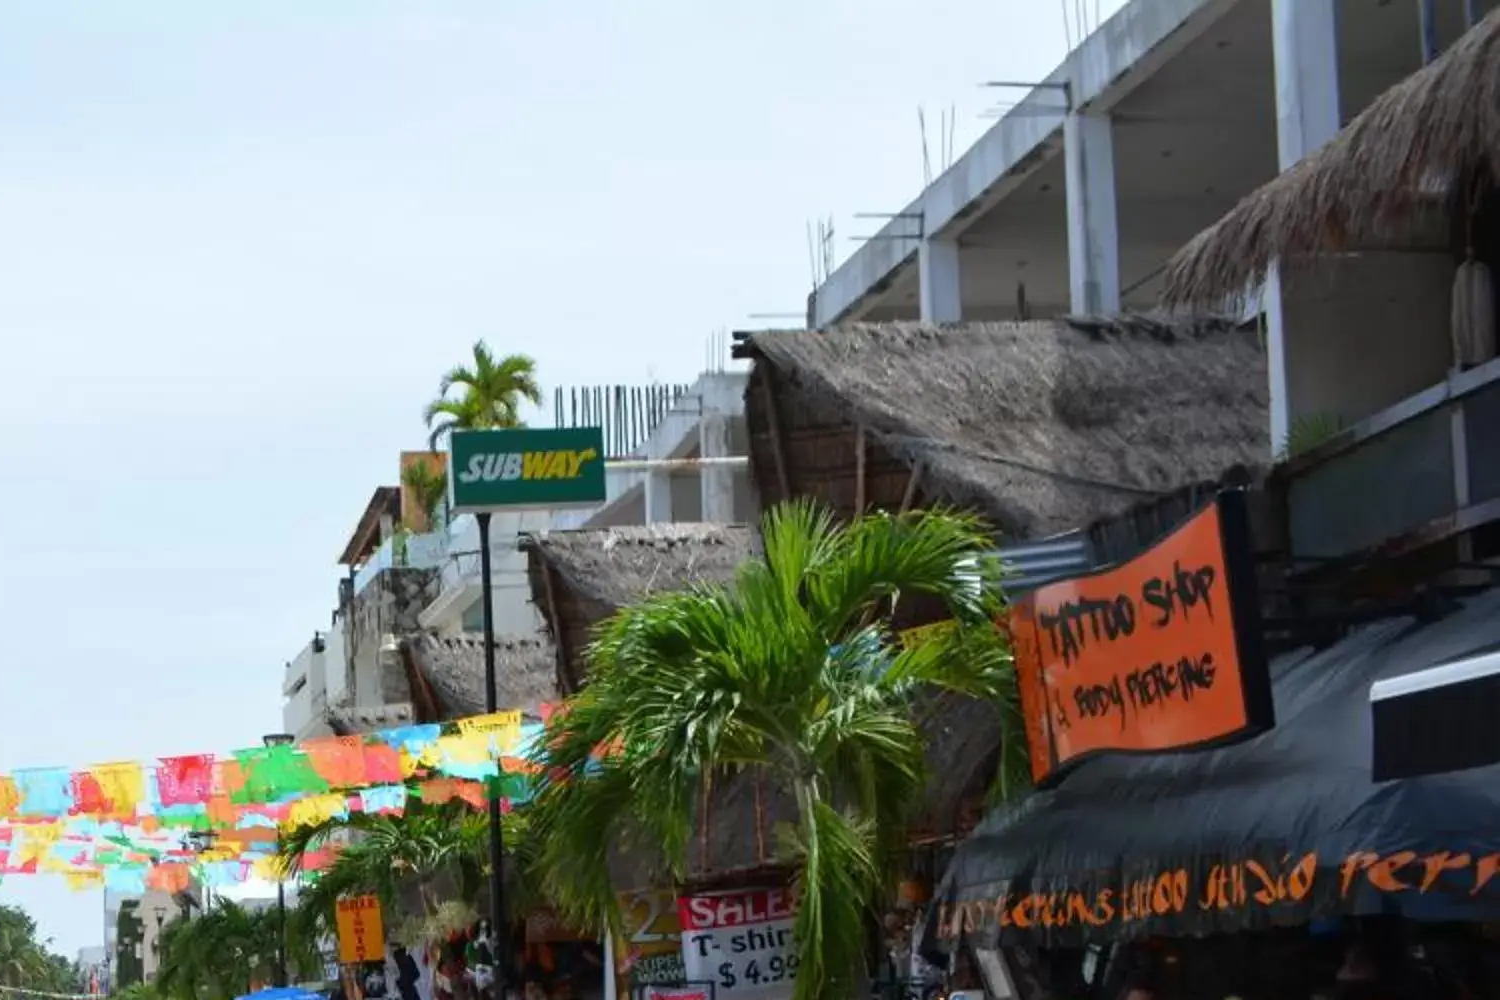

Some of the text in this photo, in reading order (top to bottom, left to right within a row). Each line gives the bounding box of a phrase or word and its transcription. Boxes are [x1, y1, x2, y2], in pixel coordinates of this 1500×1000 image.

[458, 448, 597, 483] SUBWAY
[1039, 560, 1216, 669] TATTOO SHOP
[1073, 674, 1126, 733] BODY
[1125, 652, 1217, 722] PIERCING
[731, 924, 797, 953] shir
[744, 953, 800, 985] 4.99
